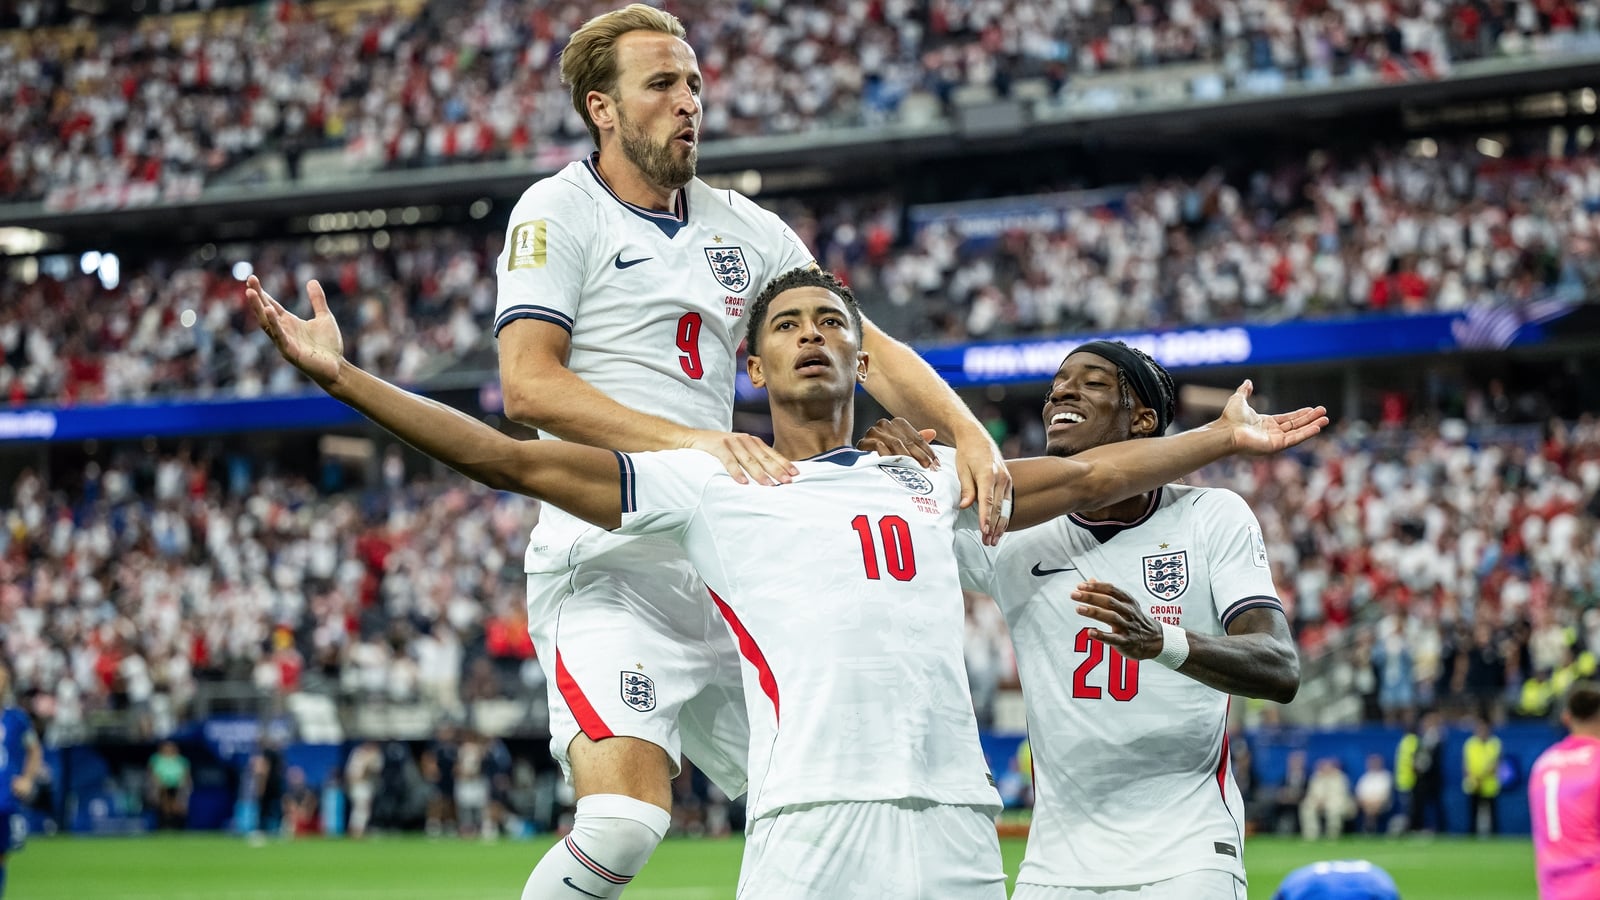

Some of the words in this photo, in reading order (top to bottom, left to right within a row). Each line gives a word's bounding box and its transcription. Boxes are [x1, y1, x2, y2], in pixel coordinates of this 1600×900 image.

[676, 312, 704, 380] 9
[851, 515, 917, 582] 10
[1150, 605, 1182, 615] CROATIA
[1154, 616, 1181, 626] 06.26
[1072, 627, 1140, 702] 20
[1543, 771, 1561, 842] 1
